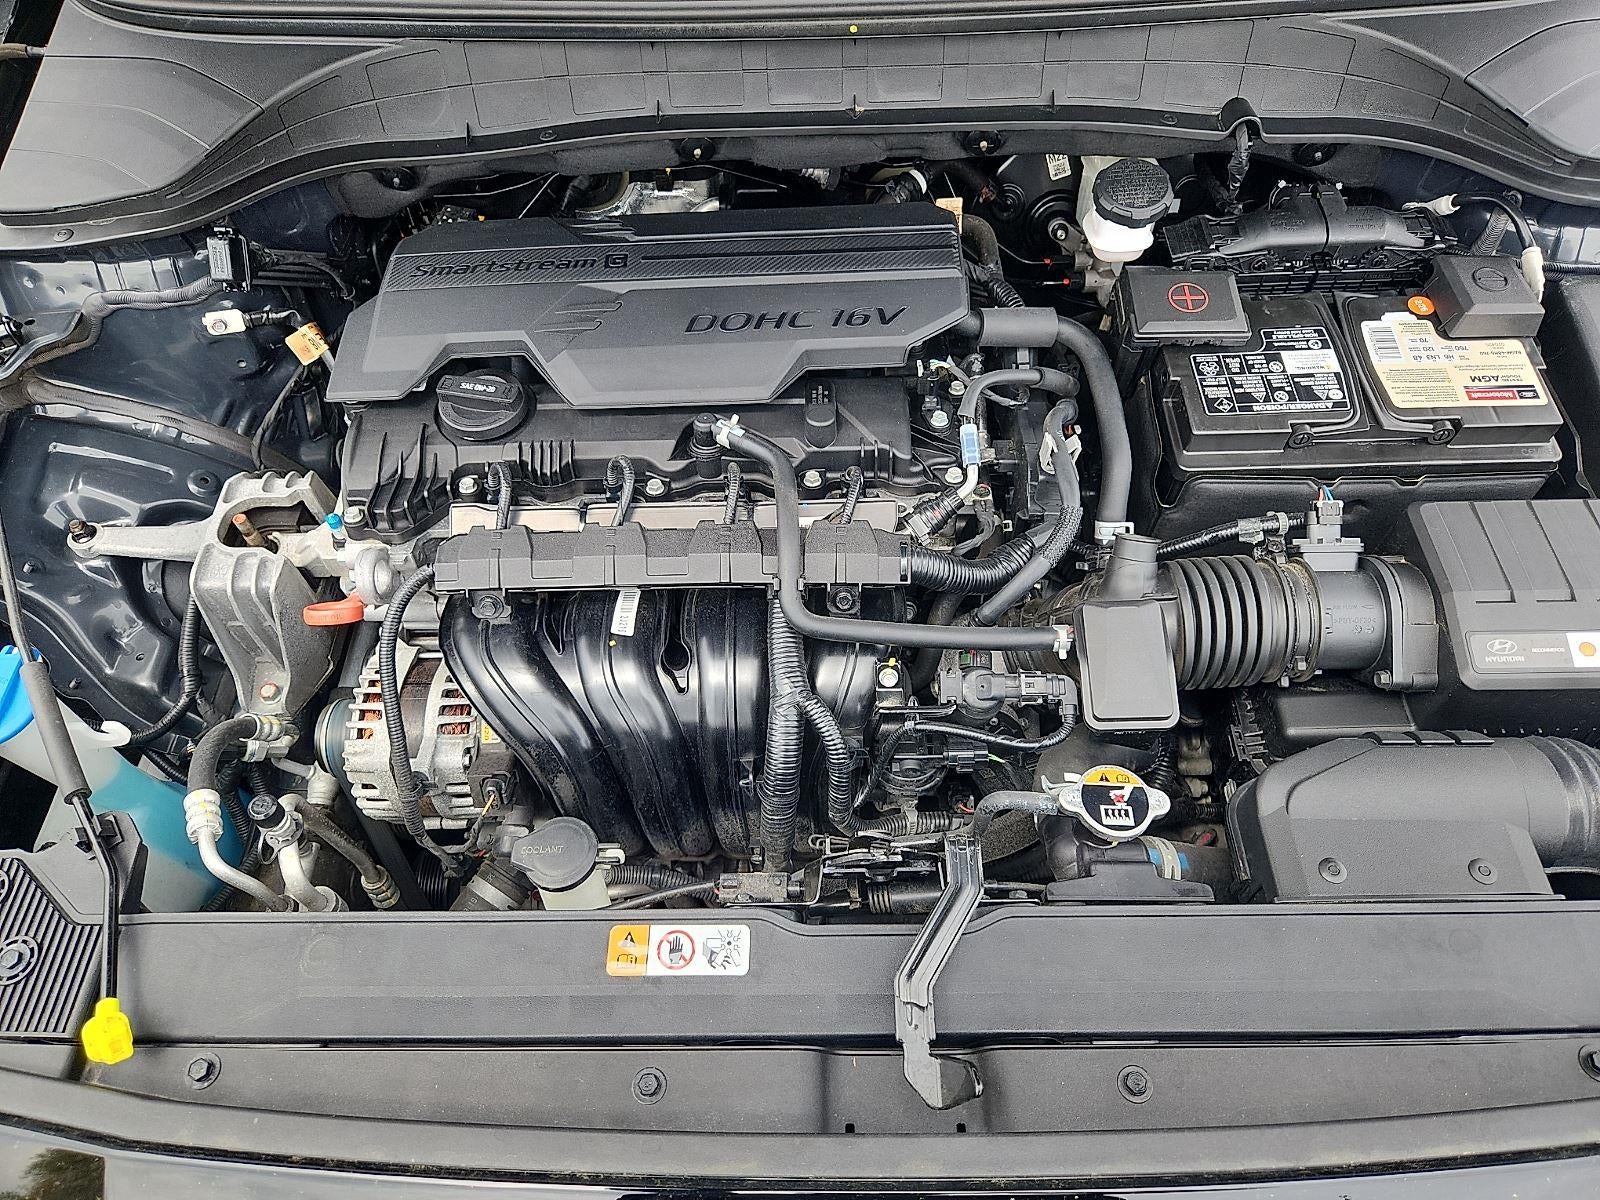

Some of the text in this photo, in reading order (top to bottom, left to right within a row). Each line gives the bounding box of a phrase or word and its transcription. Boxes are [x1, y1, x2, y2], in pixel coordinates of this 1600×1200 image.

[411, 257, 597, 279] Smartstream
[684, 305, 910, 335] DOHC 16V
[1469, 375, 1499, 383] AGM
[460, 382, 474, 390] SAE
[1485, 655, 1525, 663] HYUNDAI
[521, 845, 564, 855] COOLANT
